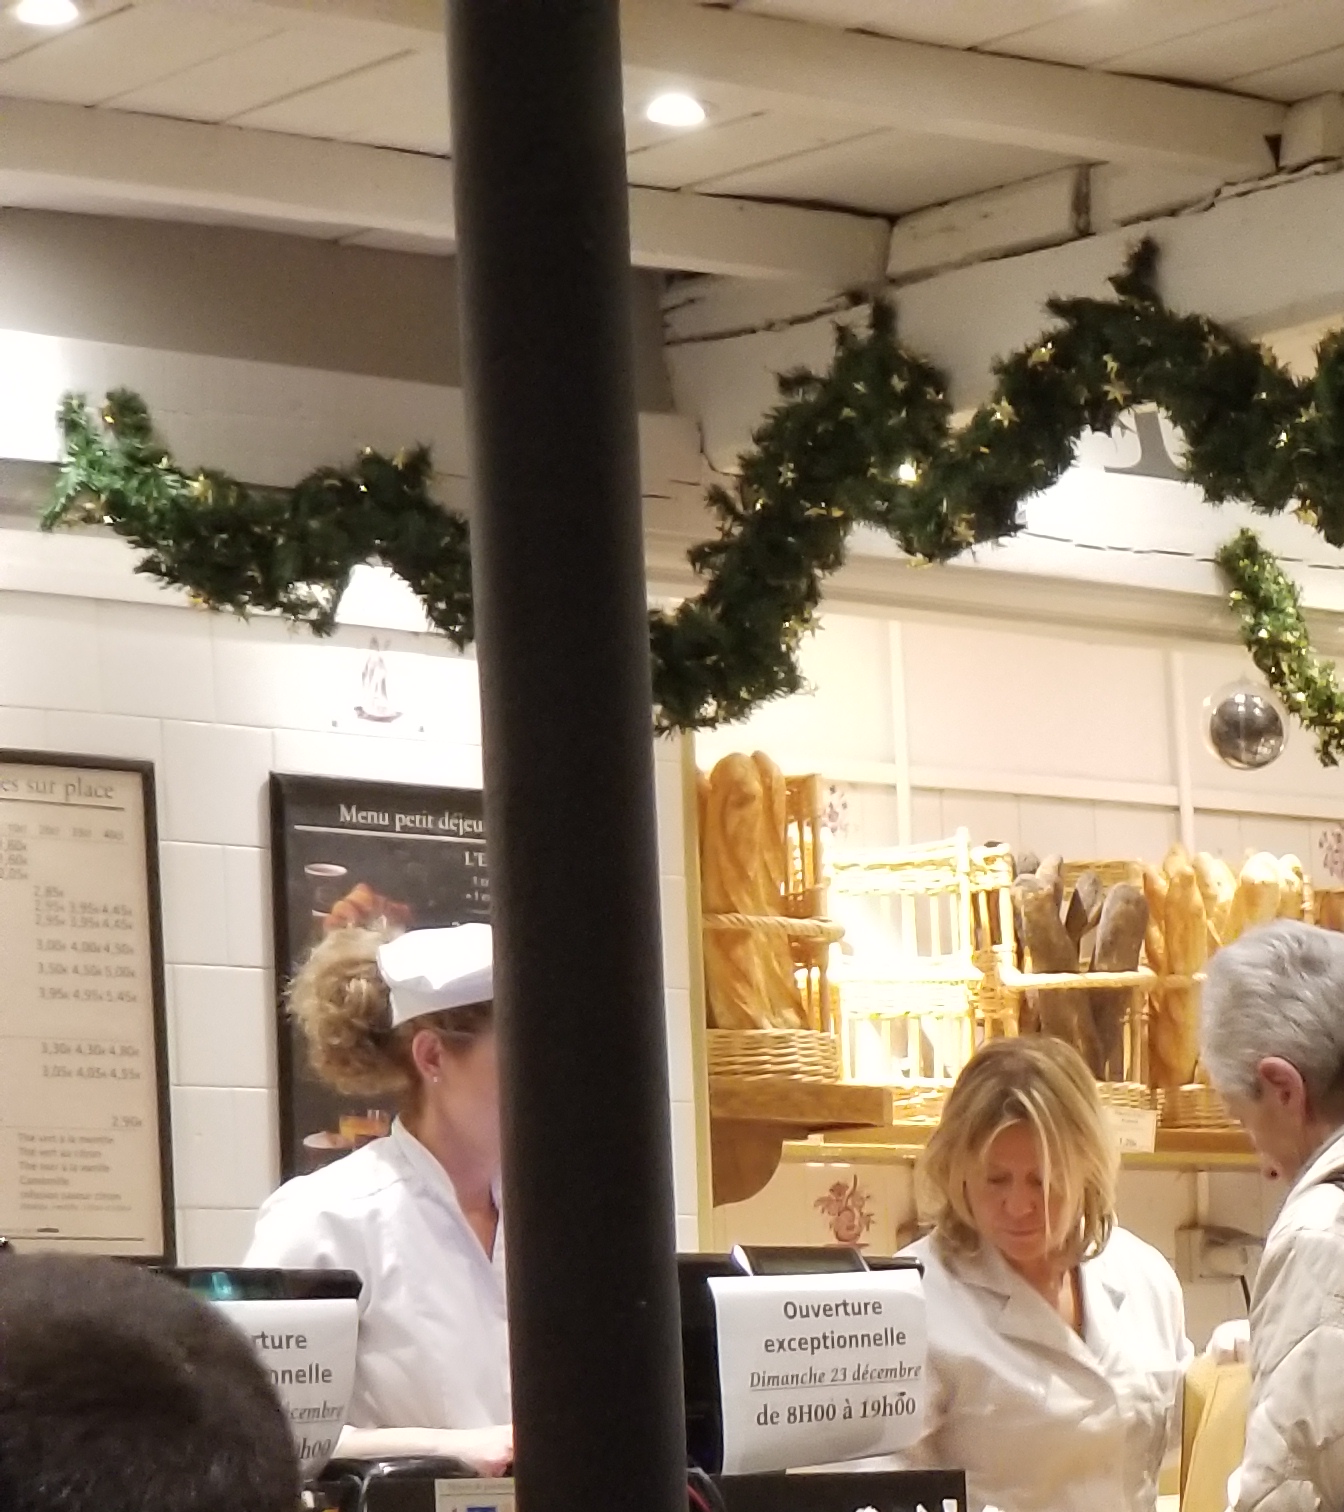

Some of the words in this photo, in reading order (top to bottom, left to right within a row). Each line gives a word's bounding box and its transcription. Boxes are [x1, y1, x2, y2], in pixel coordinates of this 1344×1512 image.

[27, 779, 56, 795] sur
[65, 777, 115, 801] place
[339, 804, 389, 825] Menu
[395, 811, 434, 832] petit
[783, 1299, 883, 1320] Ouverture
[763, 1327, 907, 1355] exceptionnelle
[750, 1365, 826, 1388] Dimanche
[830, 1367, 848, 1383] 23
[852, 1360, 922, 1382] décembre
[756, 1403, 780, 1426] de
[786, 1403, 837, 1425] 8H00
[842, 1398, 853, 1420] à
[860, 1394, 916, 1419] 19h00
